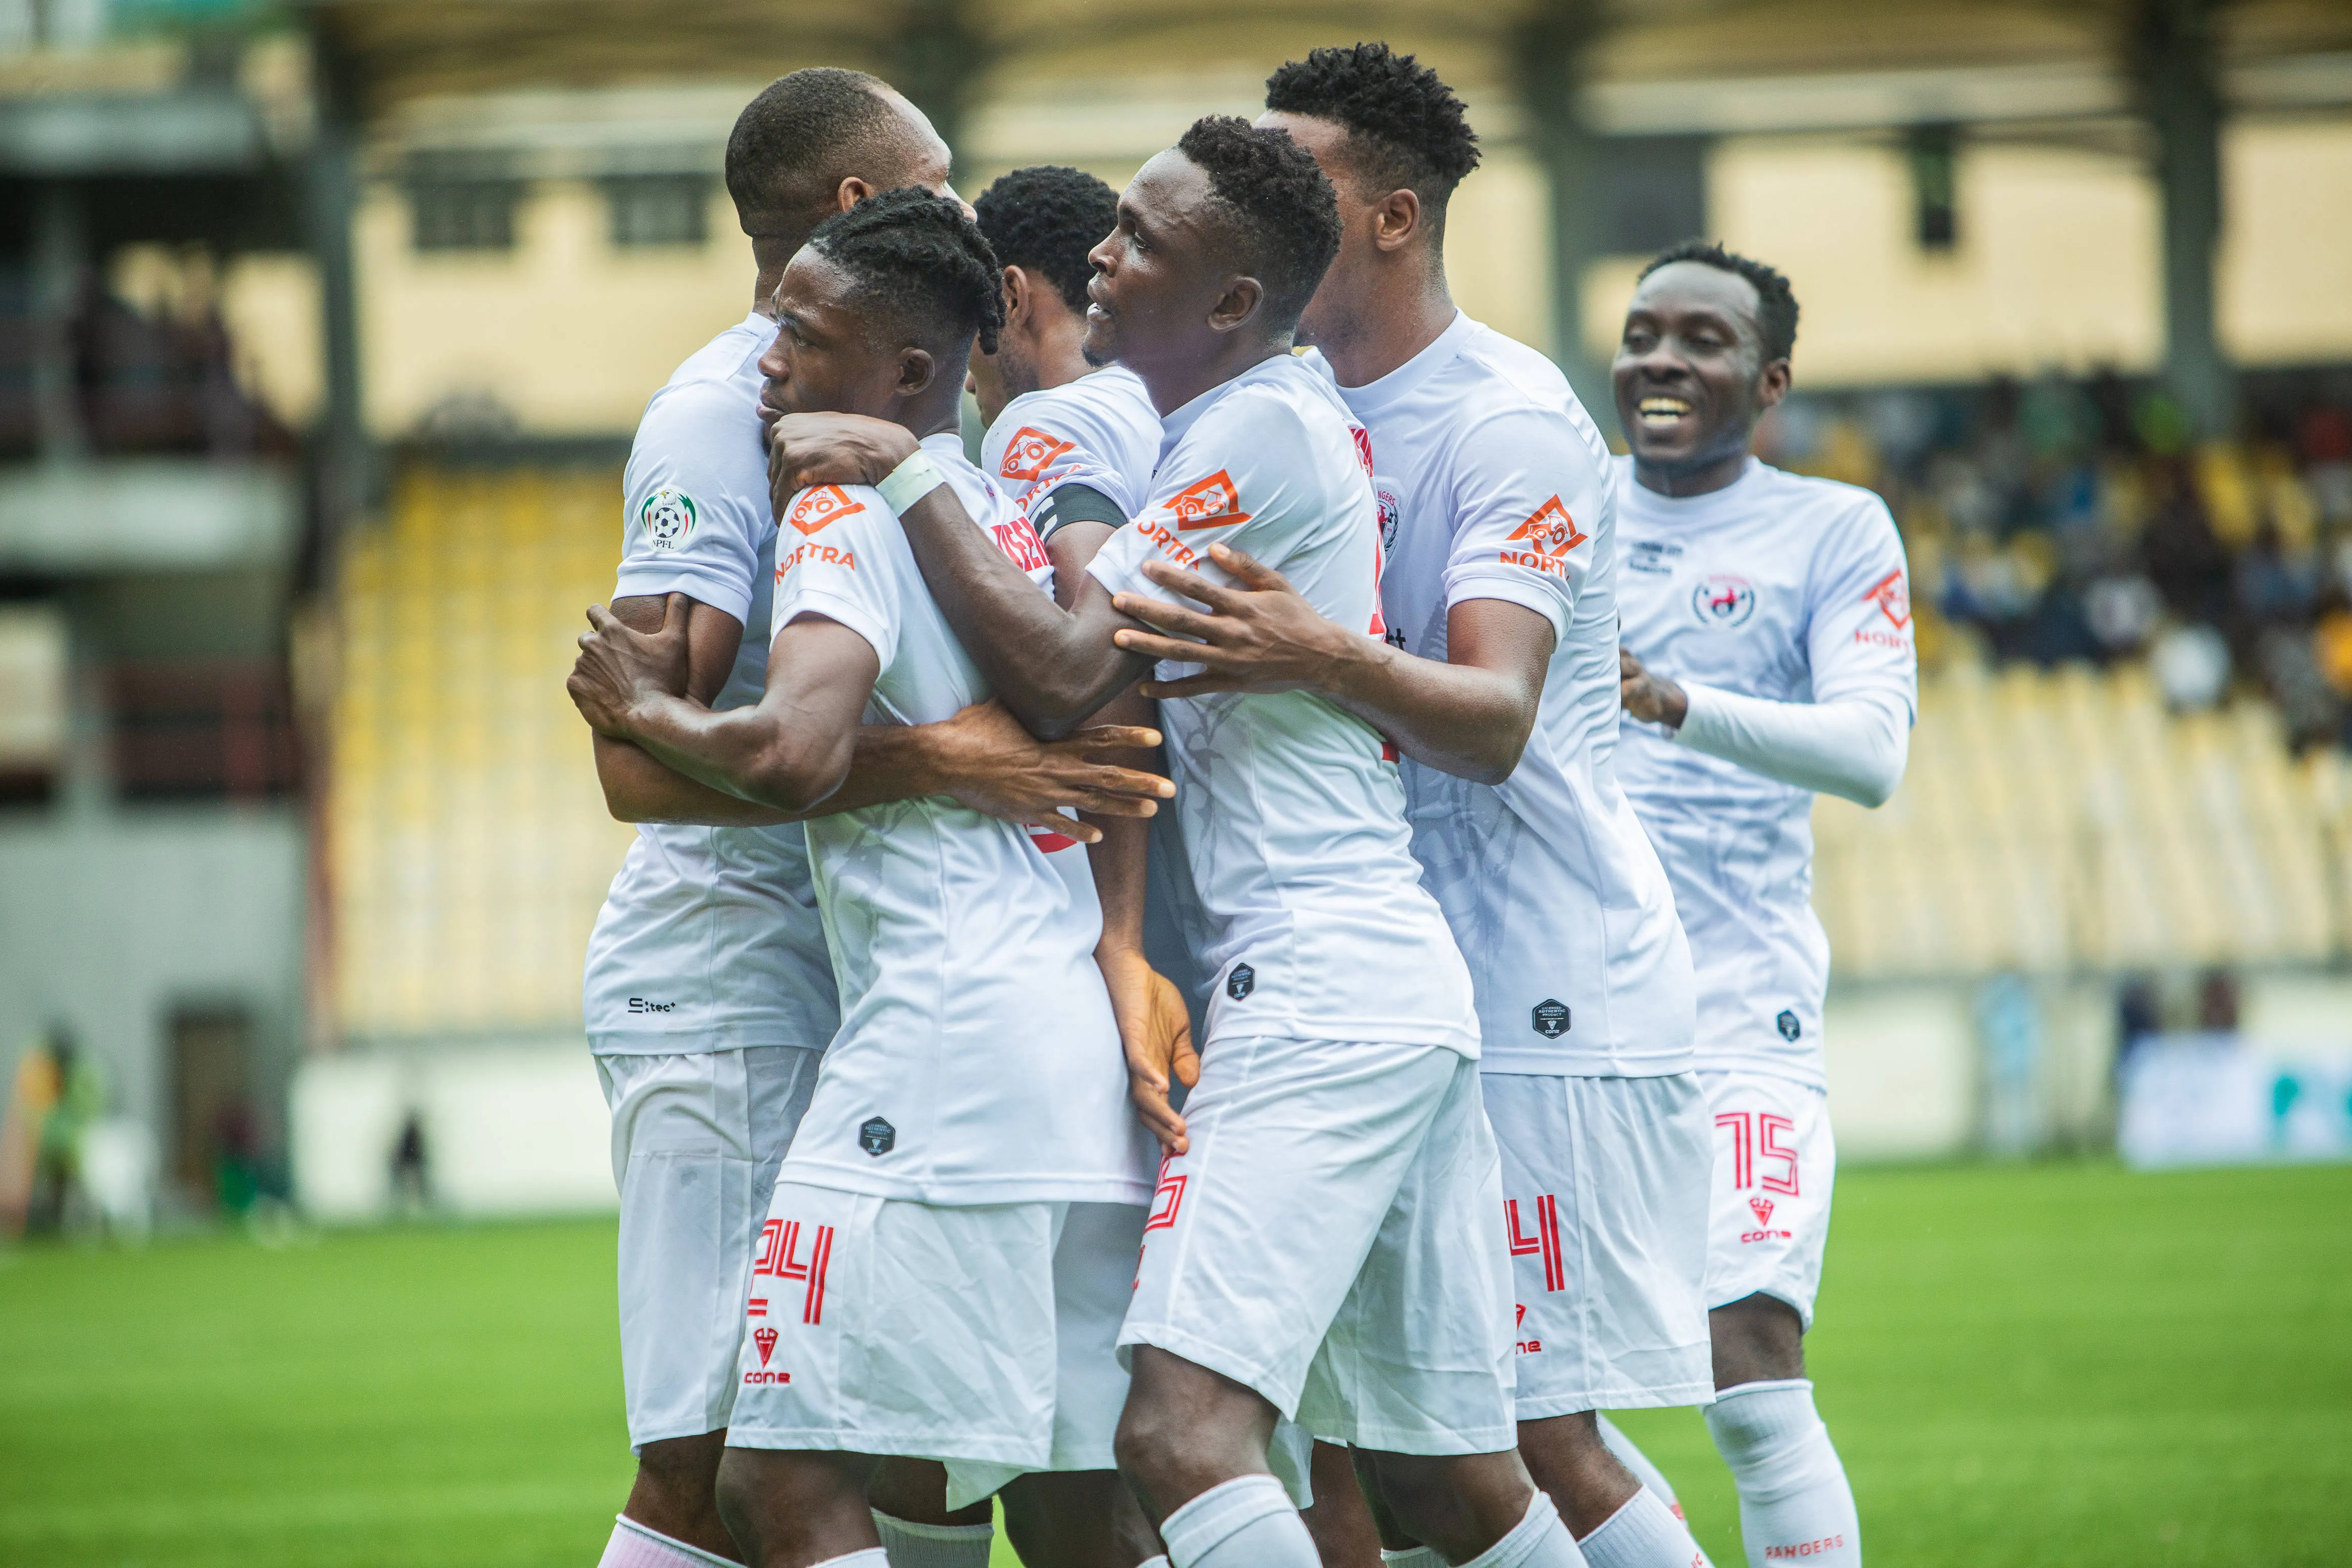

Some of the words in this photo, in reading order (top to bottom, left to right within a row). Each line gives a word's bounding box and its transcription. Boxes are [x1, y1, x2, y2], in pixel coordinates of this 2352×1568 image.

[1377, 490, 1396, 506] NGERS
[1137, 520, 1199, 571] ORTR
[1500, 552, 1570, 581] NORT
[1854, 629, 1911, 656] NORT
[1715, 1112, 1799, 1197] 15
[747, 1219, 834, 1326] 24
[1516, 1340, 1542, 1355] ne
[744, 1371, 791, 1385] cone
[1765, 1534, 1844, 1560] RANGERS
